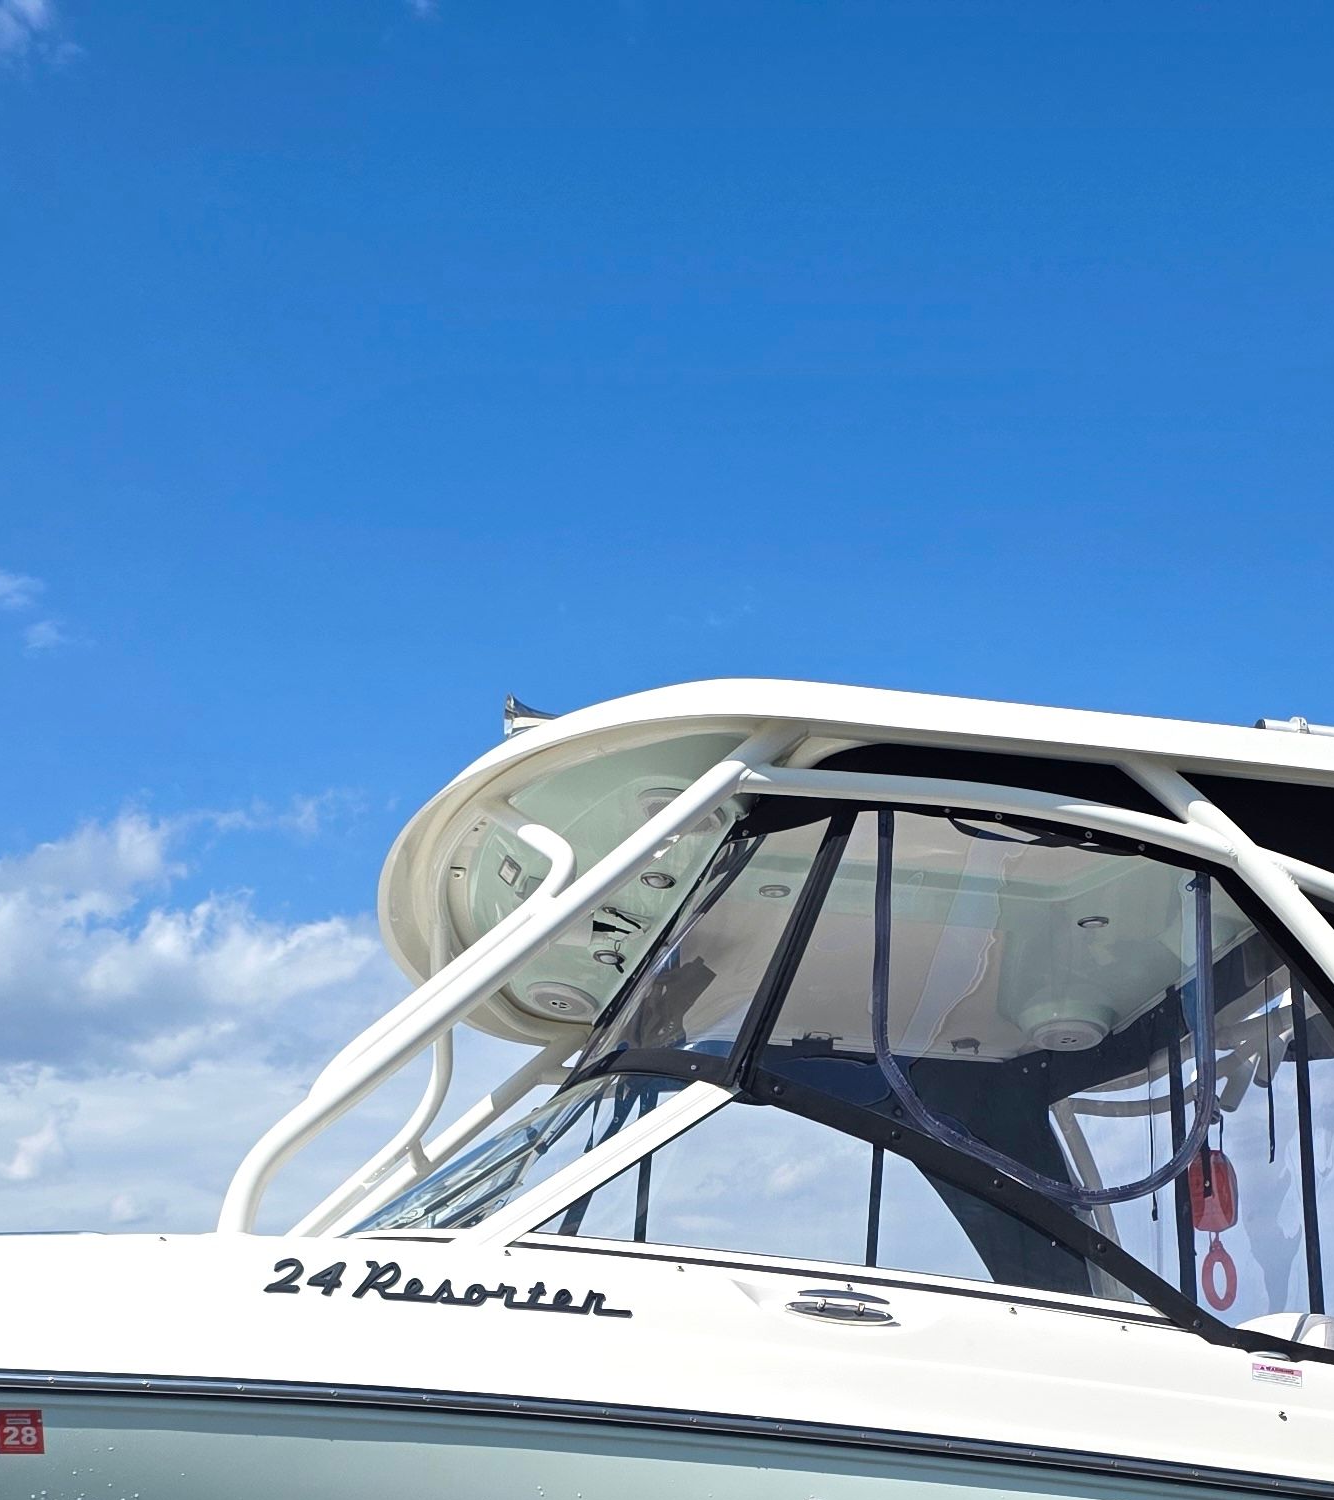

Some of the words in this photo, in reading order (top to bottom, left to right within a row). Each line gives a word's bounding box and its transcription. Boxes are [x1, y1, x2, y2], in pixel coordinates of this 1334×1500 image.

[263, 1257, 347, 1297] 24
[351, 1260, 633, 1319] Resorter
[3, 1426, 38, 1446] 28
